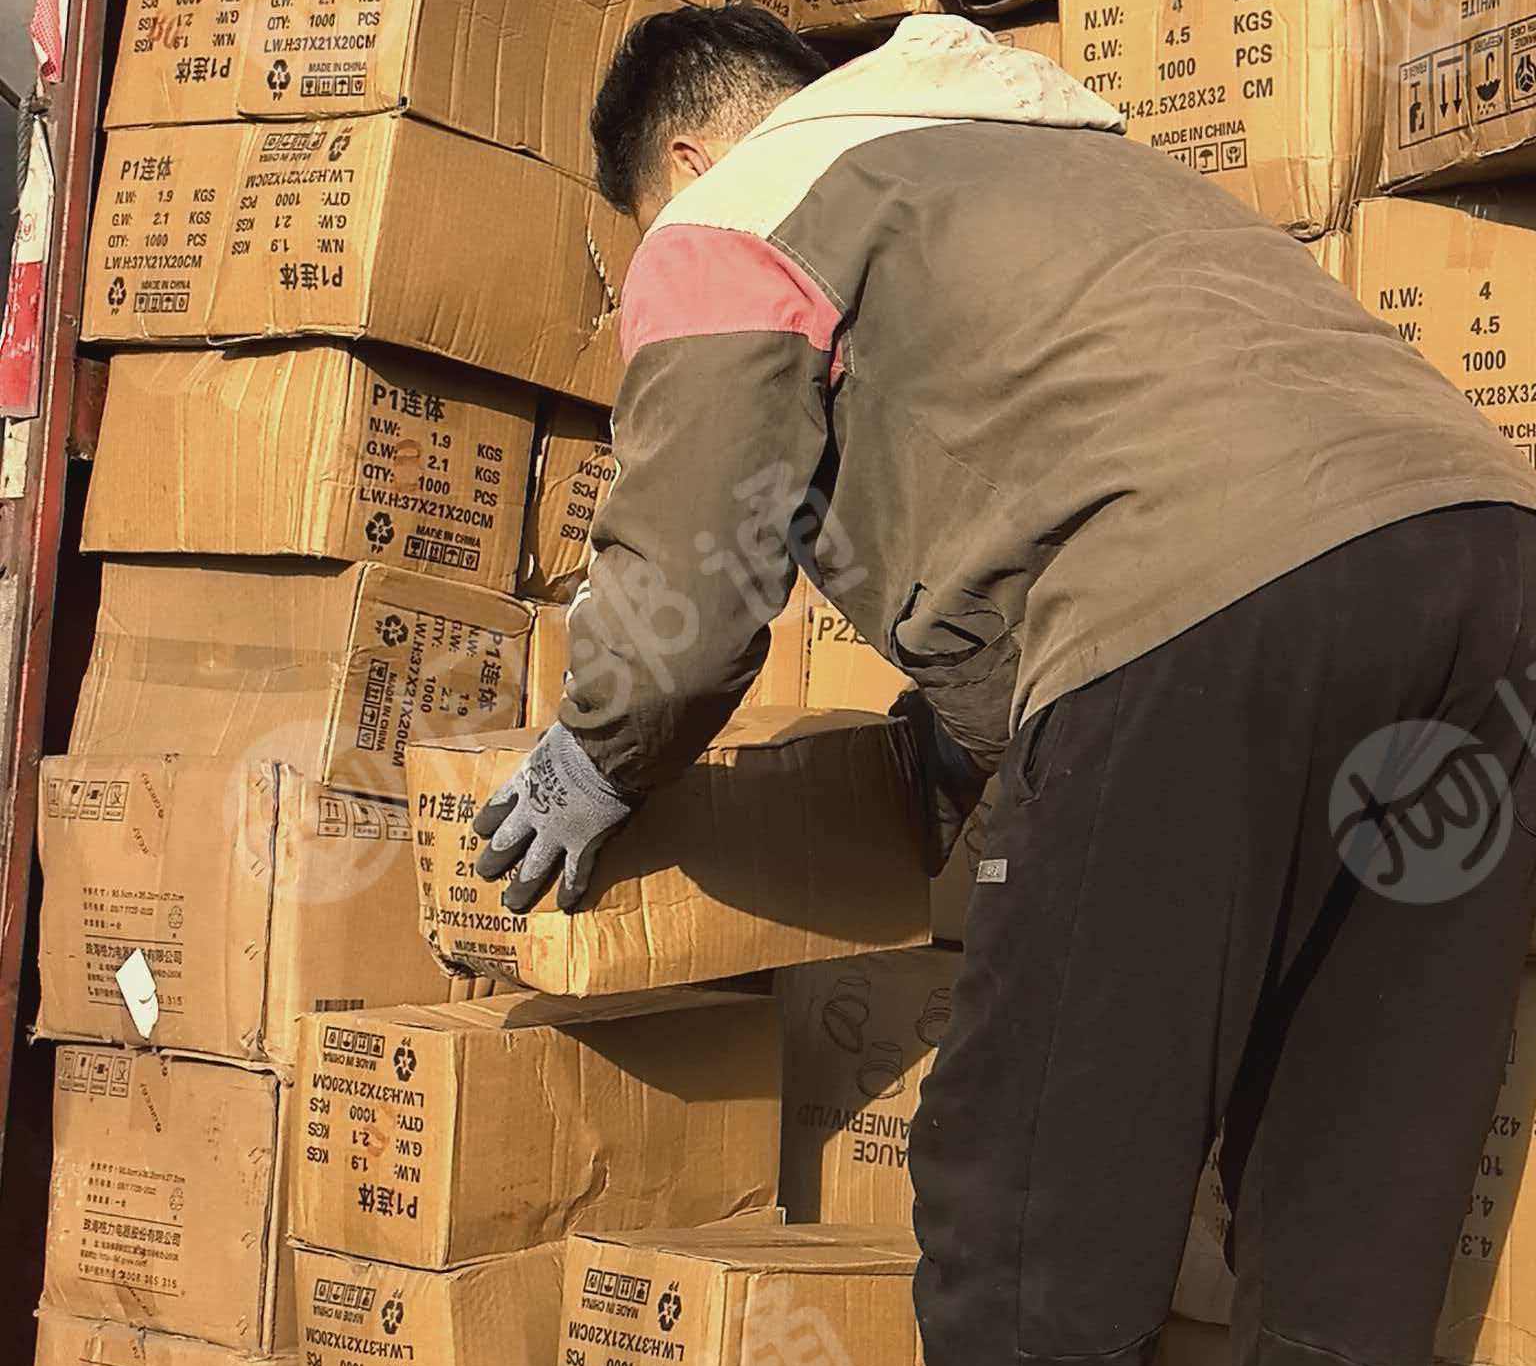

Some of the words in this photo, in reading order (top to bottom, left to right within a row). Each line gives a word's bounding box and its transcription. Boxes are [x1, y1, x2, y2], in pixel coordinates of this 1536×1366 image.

[1083, 41, 1123, 62] G.W:
[1165, 27, 1191, 45] 4.5
[1234, 12, 1273, 34] KGS
[120, 155, 173, 181] P1连体
[372, 383, 446, 423] P1连体
[369, 416, 400, 437] N.W:
[430, 432, 451, 449] 1.9
[477, 443, 503, 462] KGS
[362, 464, 395, 484] QTY:
[417, 475, 451, 495] 1000
[474, 489, 498, 508] PCS
[359, 489, 494, 529] L.W.H:37X21X20CM
[358, 1183, 418, 1219] P1连体
